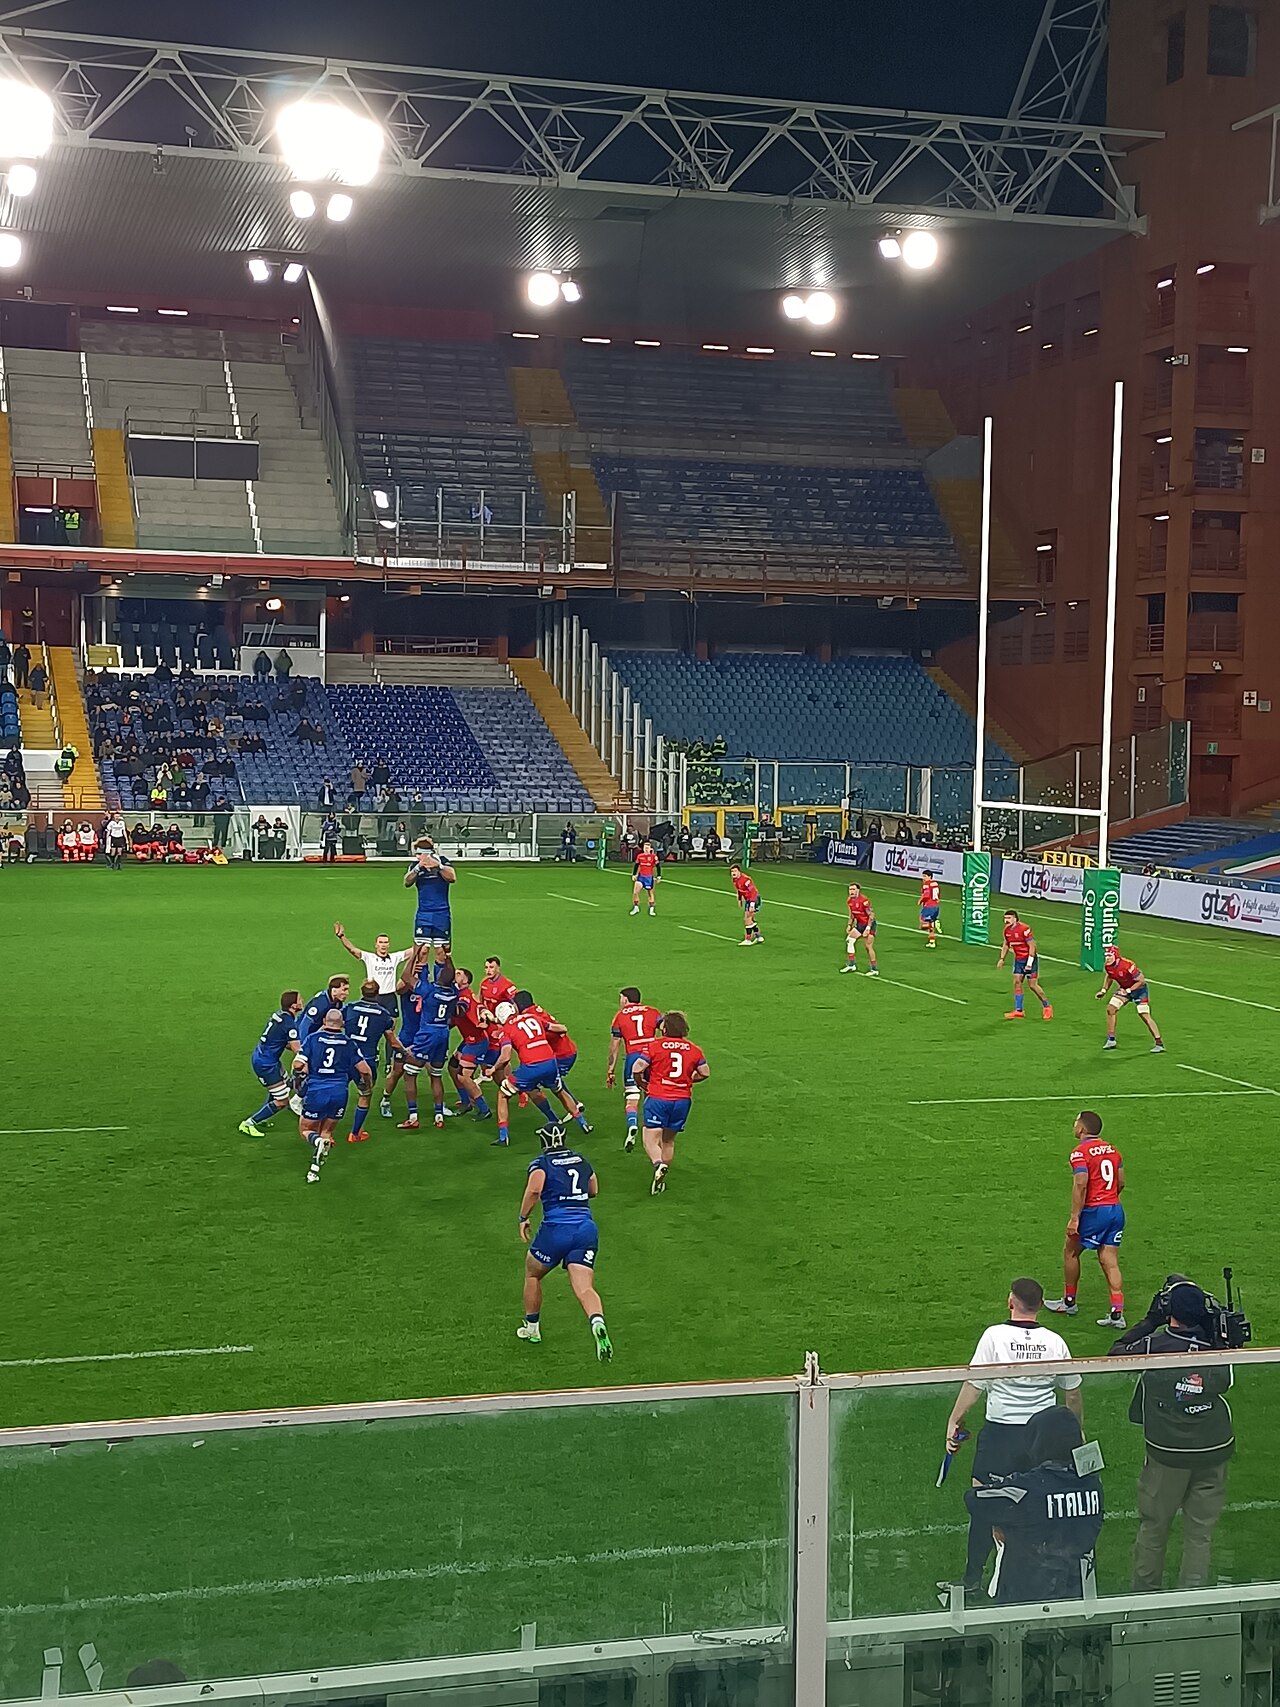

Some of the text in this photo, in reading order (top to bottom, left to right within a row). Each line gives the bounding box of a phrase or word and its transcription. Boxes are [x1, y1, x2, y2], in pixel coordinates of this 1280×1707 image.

[968, 872, 989, 927] Quilter
[1083, 889, 1096, 951] Quilter
[357, 1015, 369, 1036] 4
[517, 1017, 542, 1039] 19
[322, 1047, 335, 1068] 3
[668, 1052, 683, 1078] 3
[567, 1168, 582, 1194] 2
[1100, 1159, 1114, 1190] 9
[1010, 1342, 1047, 1352] Emirates
[1046, 1490, 1100, 1519] ITALIA
